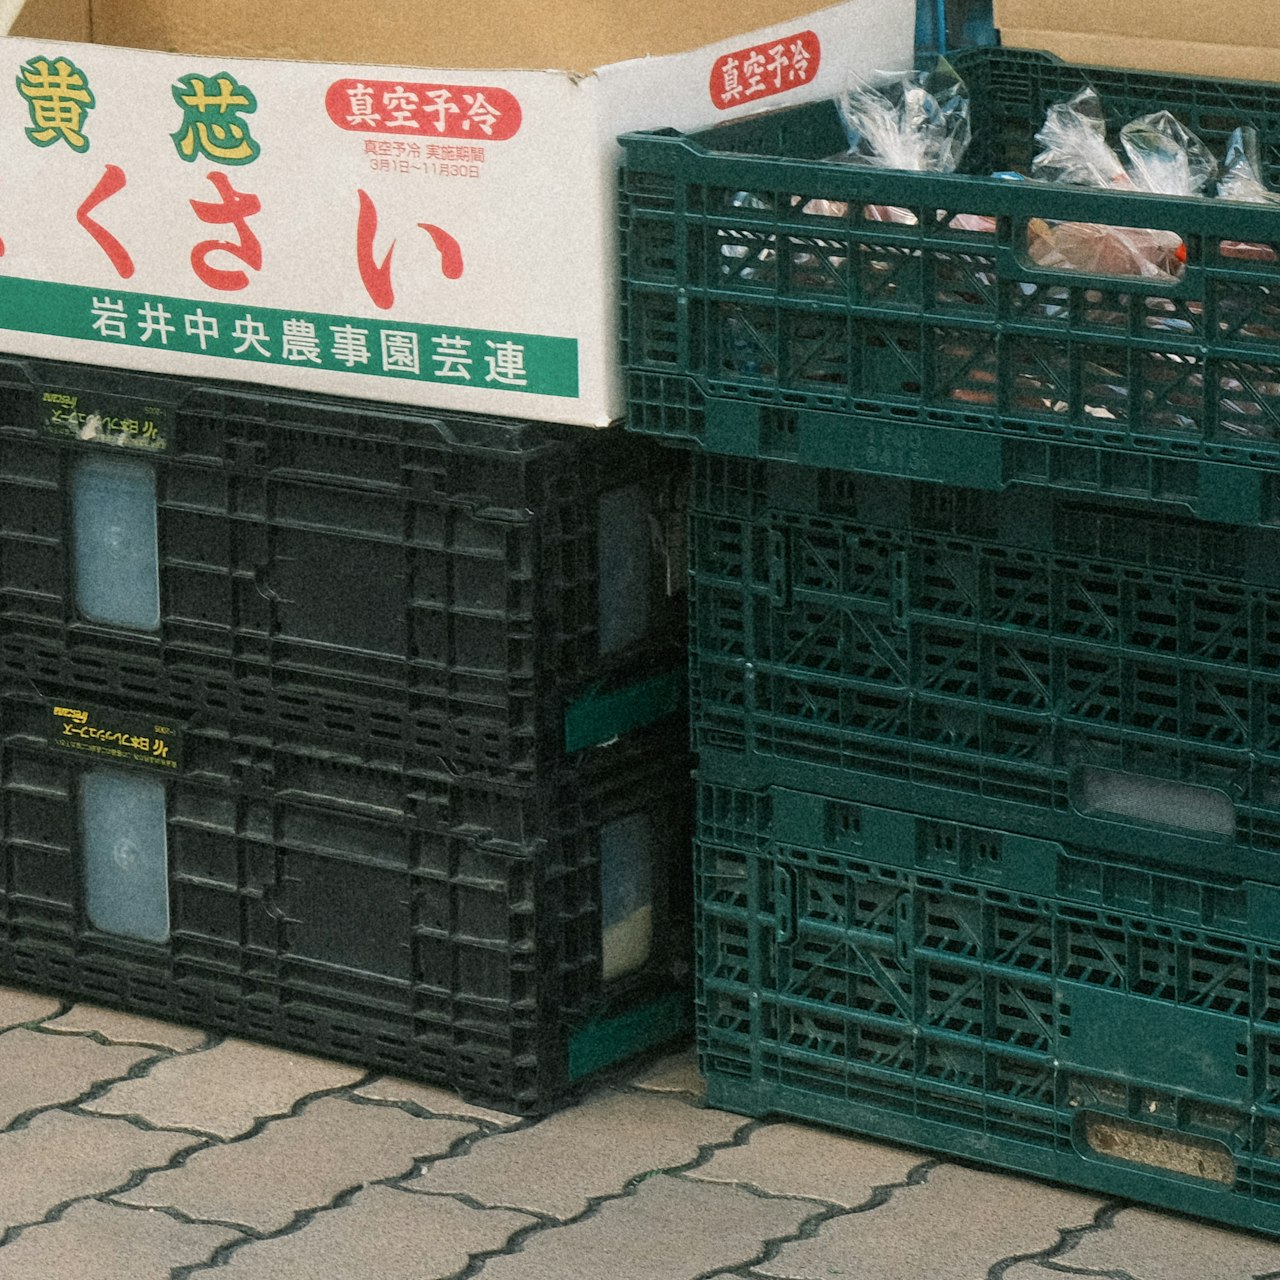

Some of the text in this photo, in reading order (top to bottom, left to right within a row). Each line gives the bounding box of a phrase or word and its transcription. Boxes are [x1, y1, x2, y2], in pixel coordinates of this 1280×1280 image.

[719, 41, 813, 102] 真空予冷
[344, 83, 503, 136] 真空予冷
[363, 139, 486, 164] 真空予冷 実施期間
[89, 294, 528, 388] 岩井中央農事園芸連
